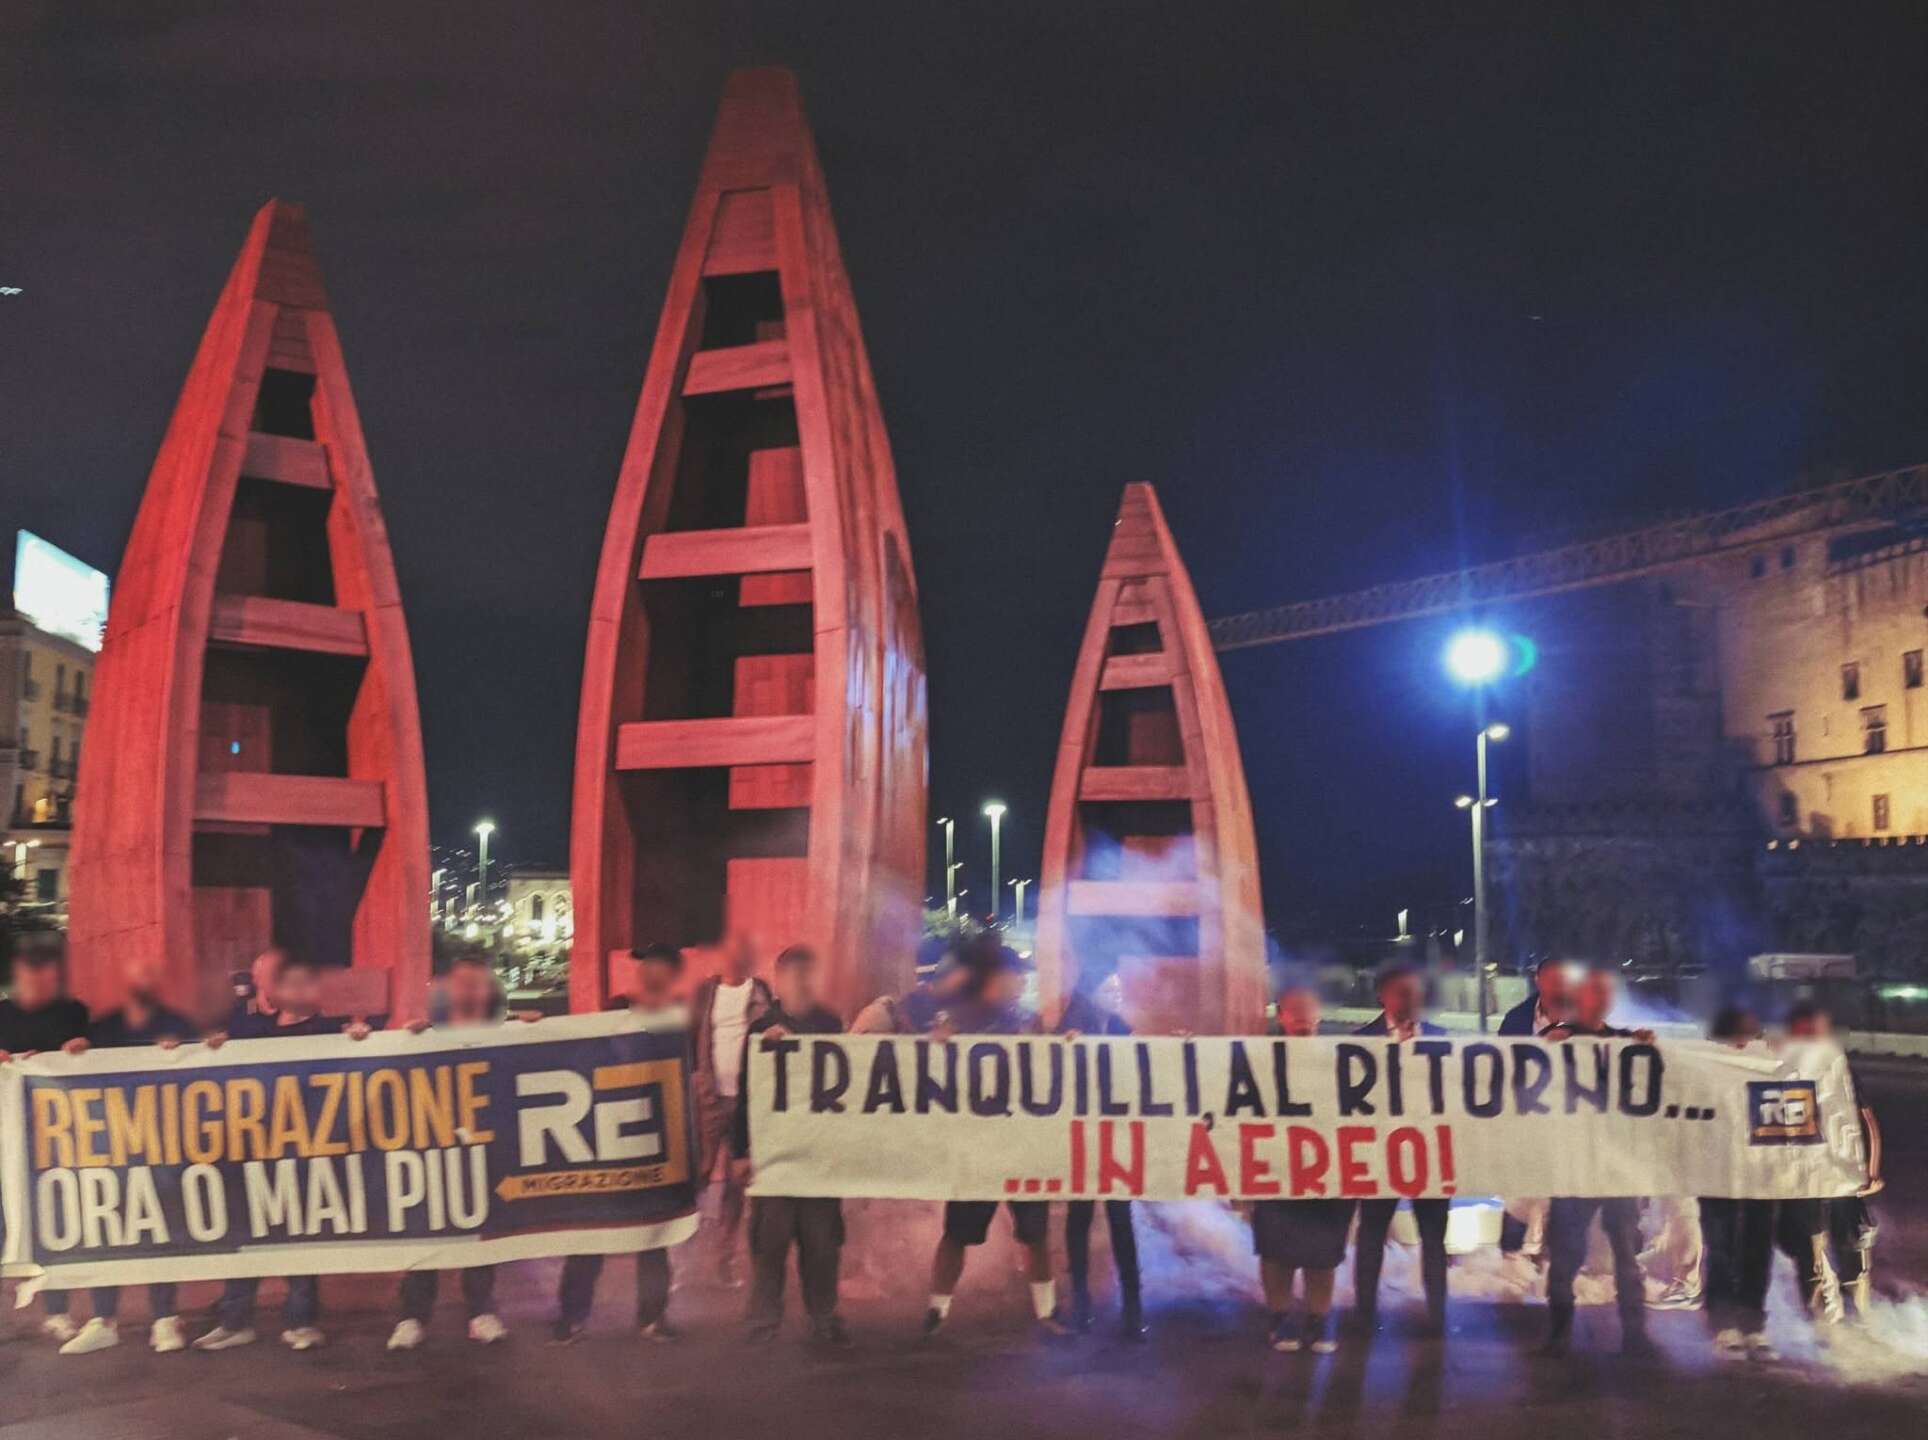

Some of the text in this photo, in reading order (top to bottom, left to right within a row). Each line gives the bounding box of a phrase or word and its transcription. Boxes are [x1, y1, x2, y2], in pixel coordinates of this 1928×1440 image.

[34, 1062, 494, 1168] REMIGRAZIONE
[516, 1069, 661, 1167] RE
[1336, 1042, 1715, 1122] RITORNO...
[37, 1166, 170, 1251] ORA
[181, 1163, 229, 1242] O
[244, 1153, 368, 1238] MAI
[522, 1167, 664, 1190] MIGRAZIONE
[1184, 1120, 1456, 1197] AEREO!
